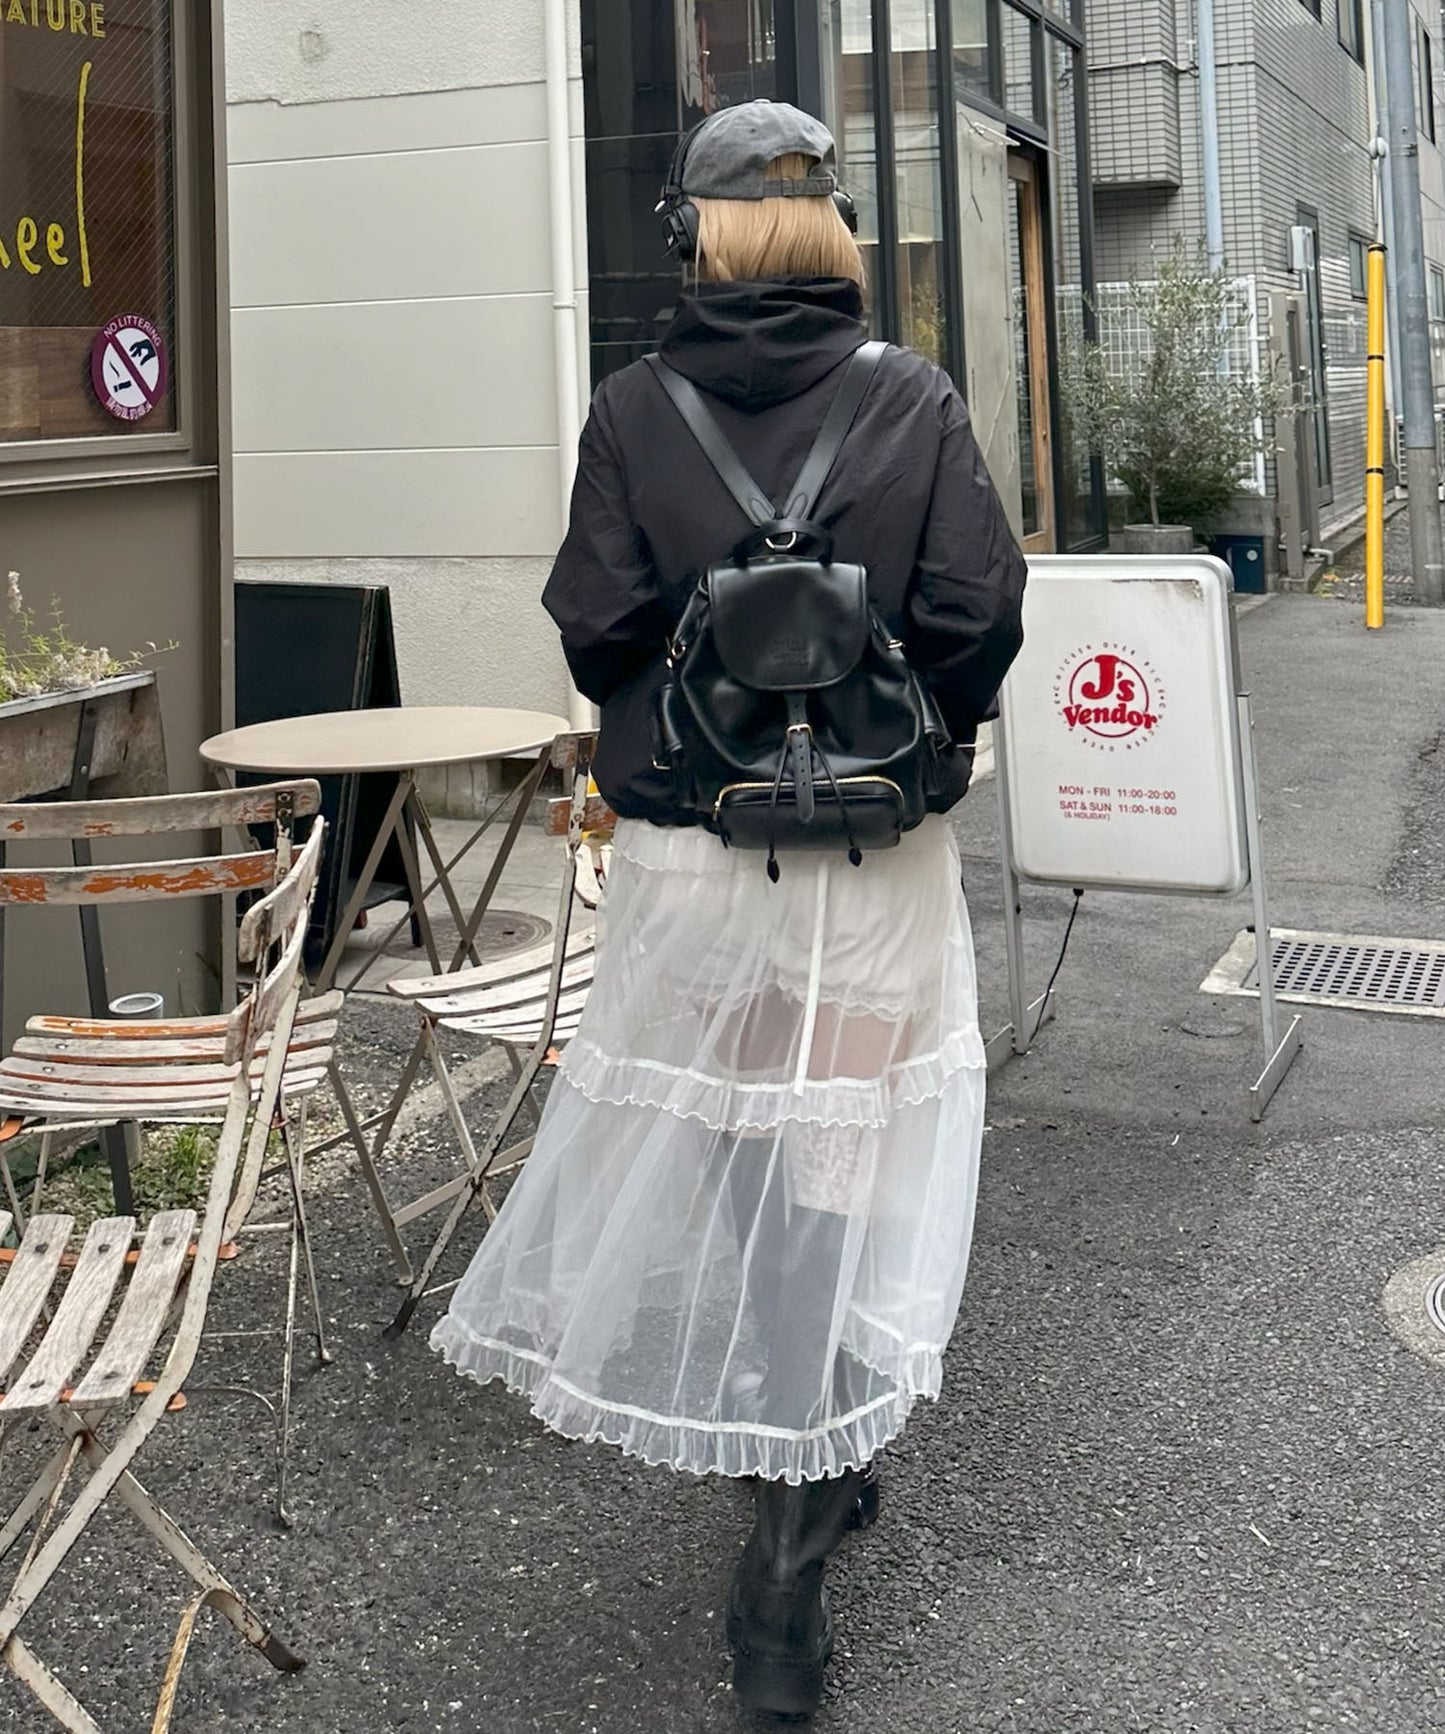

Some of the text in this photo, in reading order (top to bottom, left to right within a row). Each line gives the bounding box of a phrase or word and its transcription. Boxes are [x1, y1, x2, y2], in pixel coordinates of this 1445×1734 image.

[0, 0, 106, 37] ATURE
[104, 315, 162, 346] NO LITTERING
[1081, 654, 1135, 702] J's
[1063, 702, 1158, 729] Vendor
[1058, 785, 1084, 795] MON
[1093, 787, 1111, 796] FRI
[1117, 788, 1176, 800] 11:00-20:00
[1059, 800, 1177, 816] SAT & SUN 11:00-18:00
